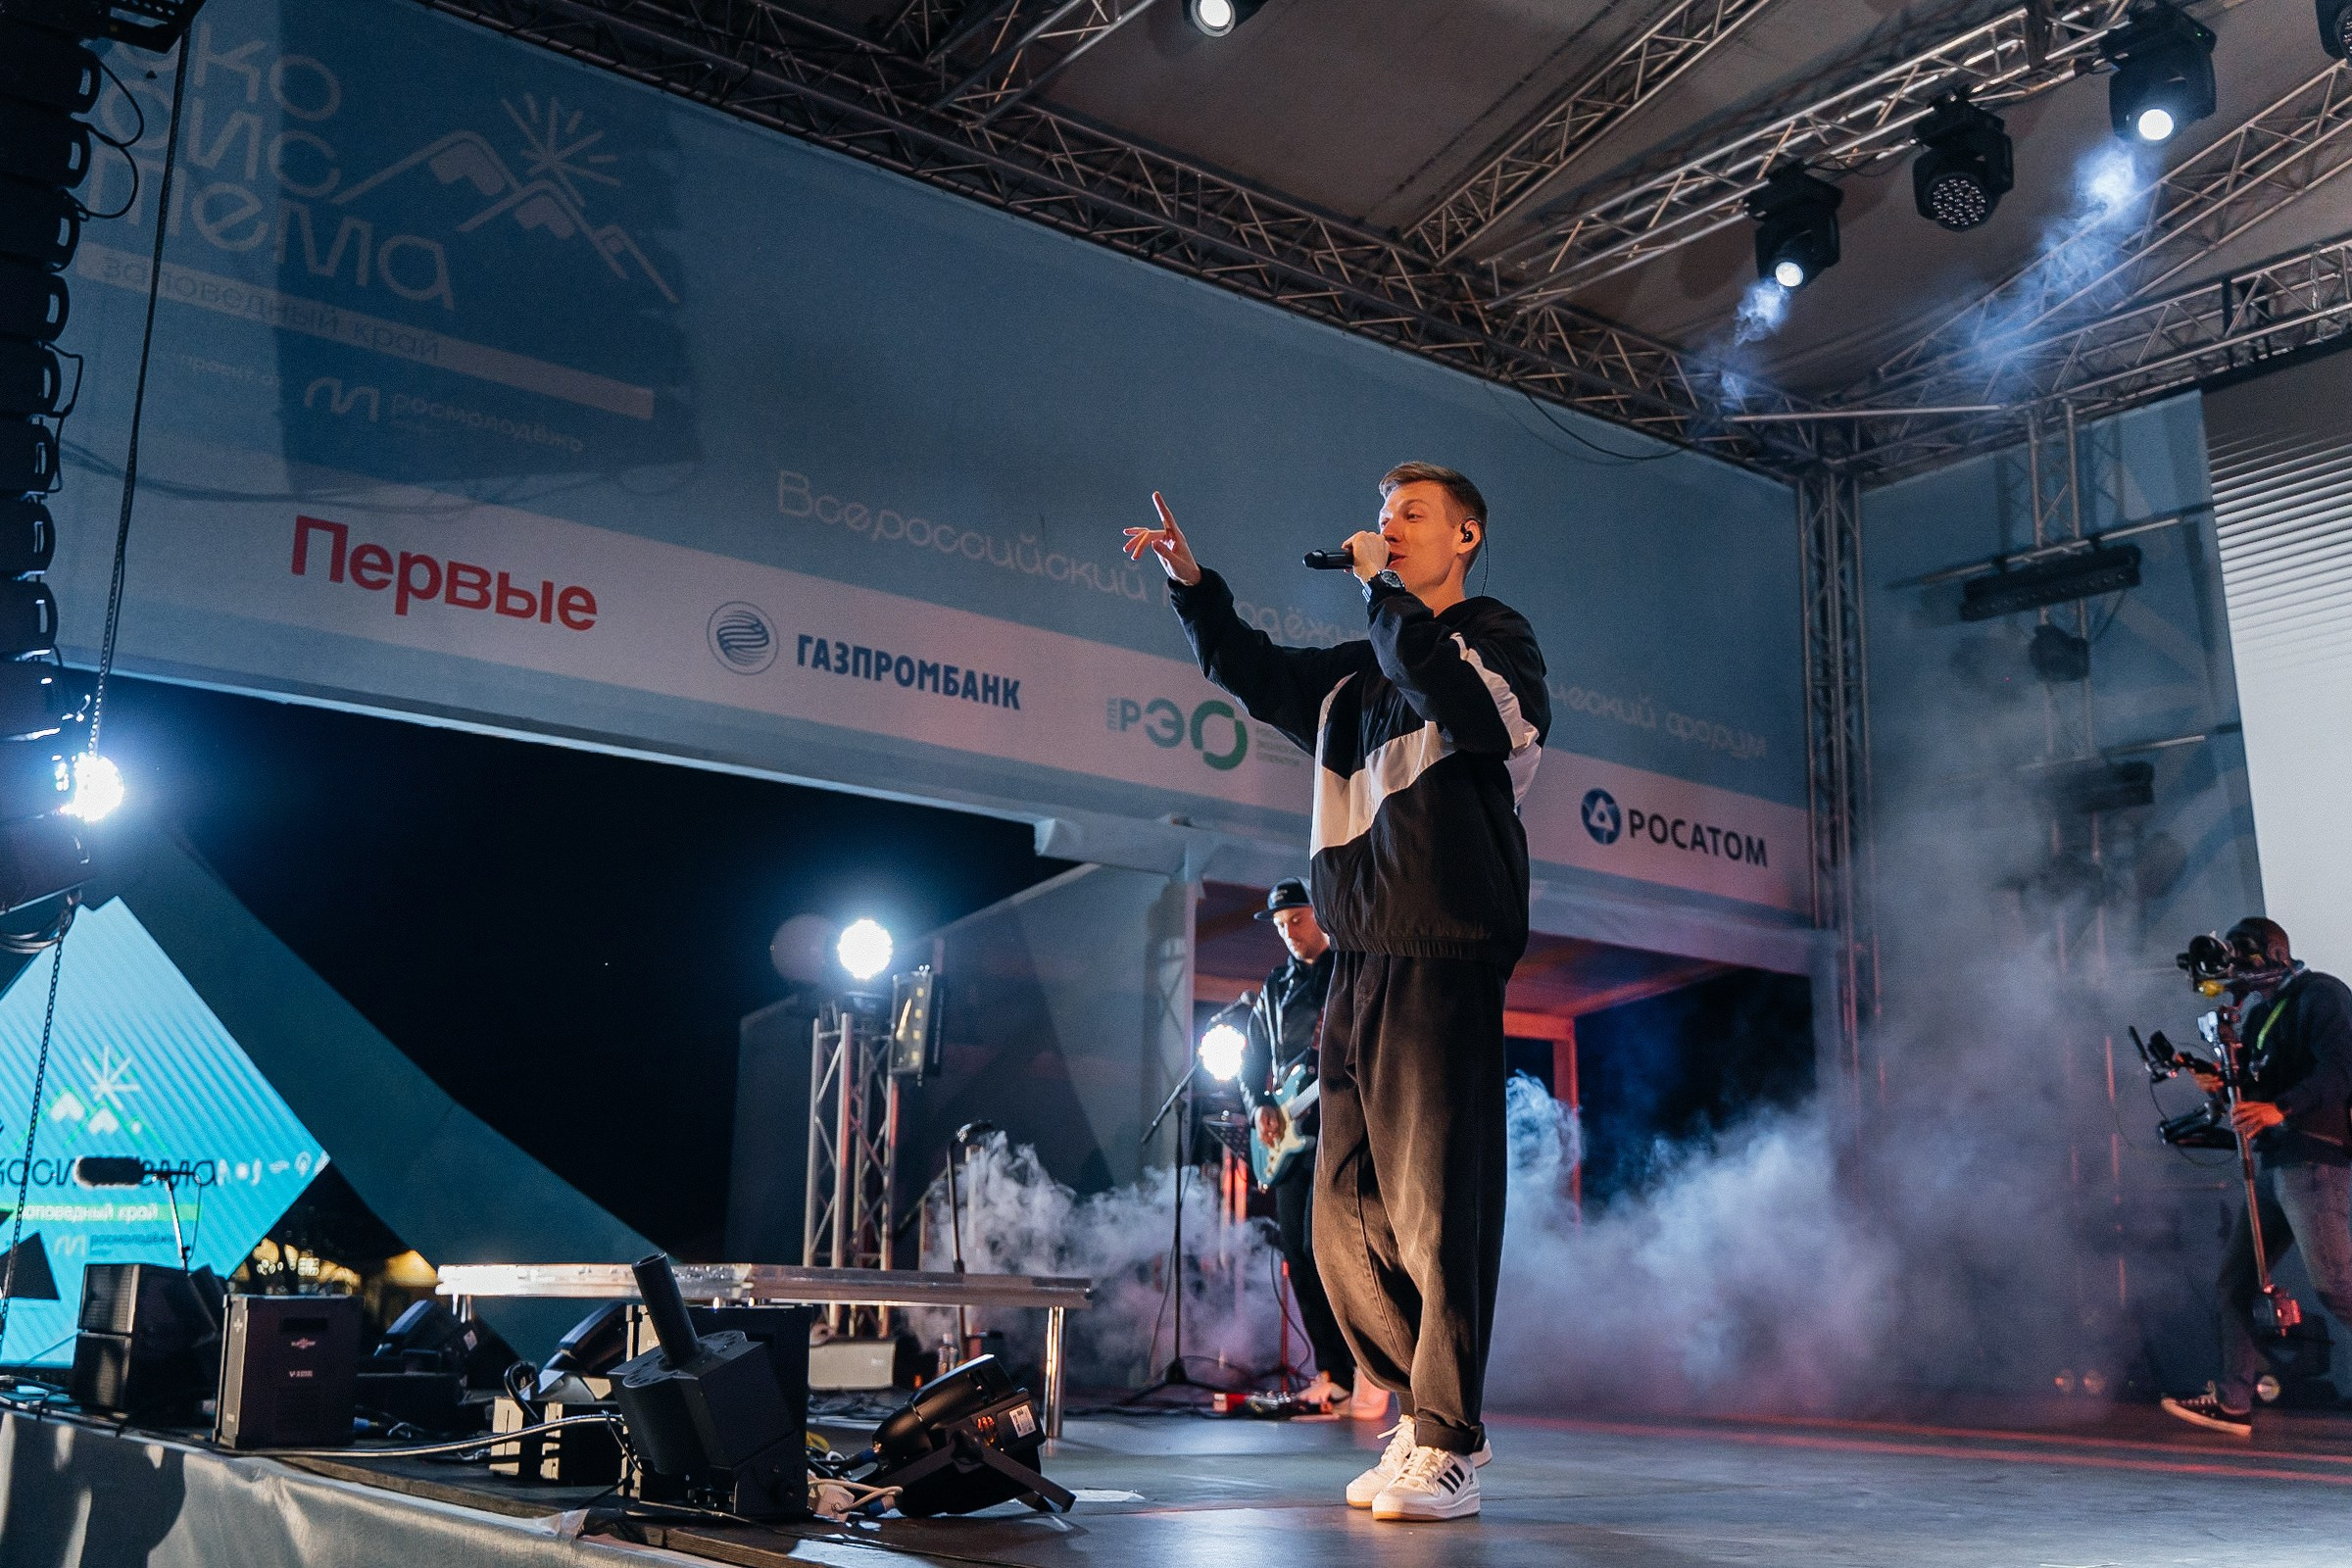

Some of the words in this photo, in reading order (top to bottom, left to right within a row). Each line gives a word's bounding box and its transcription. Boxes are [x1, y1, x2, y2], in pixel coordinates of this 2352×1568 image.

[85, 143, 455, 312] тема
[103, 256, 339, 335] заповедный
[353, 320, 439, 362] край
[291, 514, 598, 631] Первые
[777, 468, 1149, 604] Всероссийский
[1664, 710, 1767, 760] форум
[797, 632, 1021, 710] ГАЗПРОМБАНК
[1627, 807, 1769, 868] РОСАТОМ
[22, 1202, 114, 1225] аповедный
